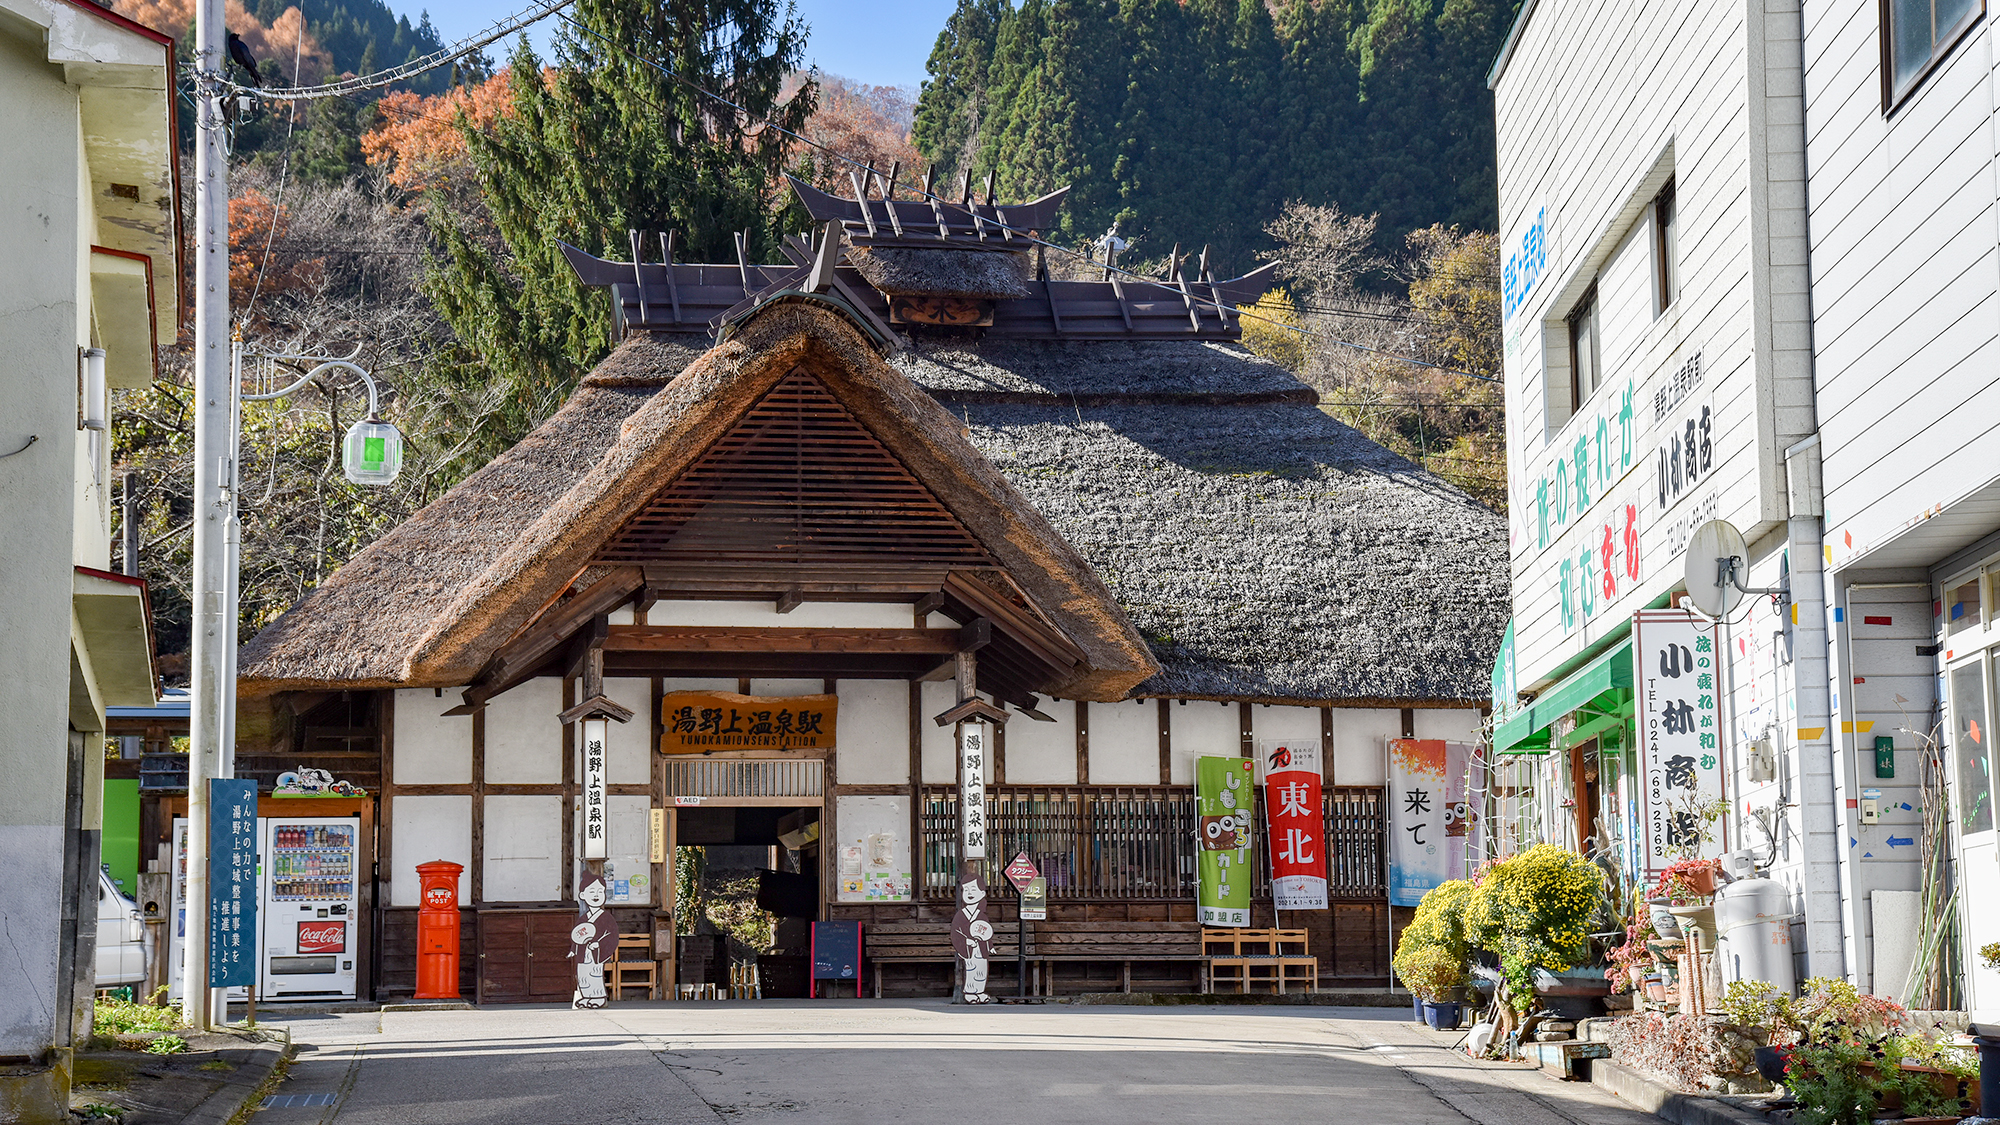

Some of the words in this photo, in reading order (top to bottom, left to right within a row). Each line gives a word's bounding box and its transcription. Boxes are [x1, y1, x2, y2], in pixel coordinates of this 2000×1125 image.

[1654, 350, 1703, 425] 湯野上温泉駅前
[1536, 378, 1634, 550] 旅の疲れが
[1657, 404, 1712, 509] 小林商店
[671, 706, 824, 738] 湯野上温泉駅
[1696, 635, 1717, 771] 旅の疲れが和む
[588, 740, 603, 840] 湯野上温泉駅
[966, 734, 983, 847] 湯野上温泉駅
[1276, 781, 1315, 865] 東北
[1404, 787, 1431, 845] 来て
[243, 790, 252, 881] みんなの力で
[1011, 867, 1033, 875] タクシー
[231, 805, 242, 963] 湯野上地域整備事業を
[1204, 909, 1243, 923] 加盟店
[221, 901, 231, 980] 推進しよう
